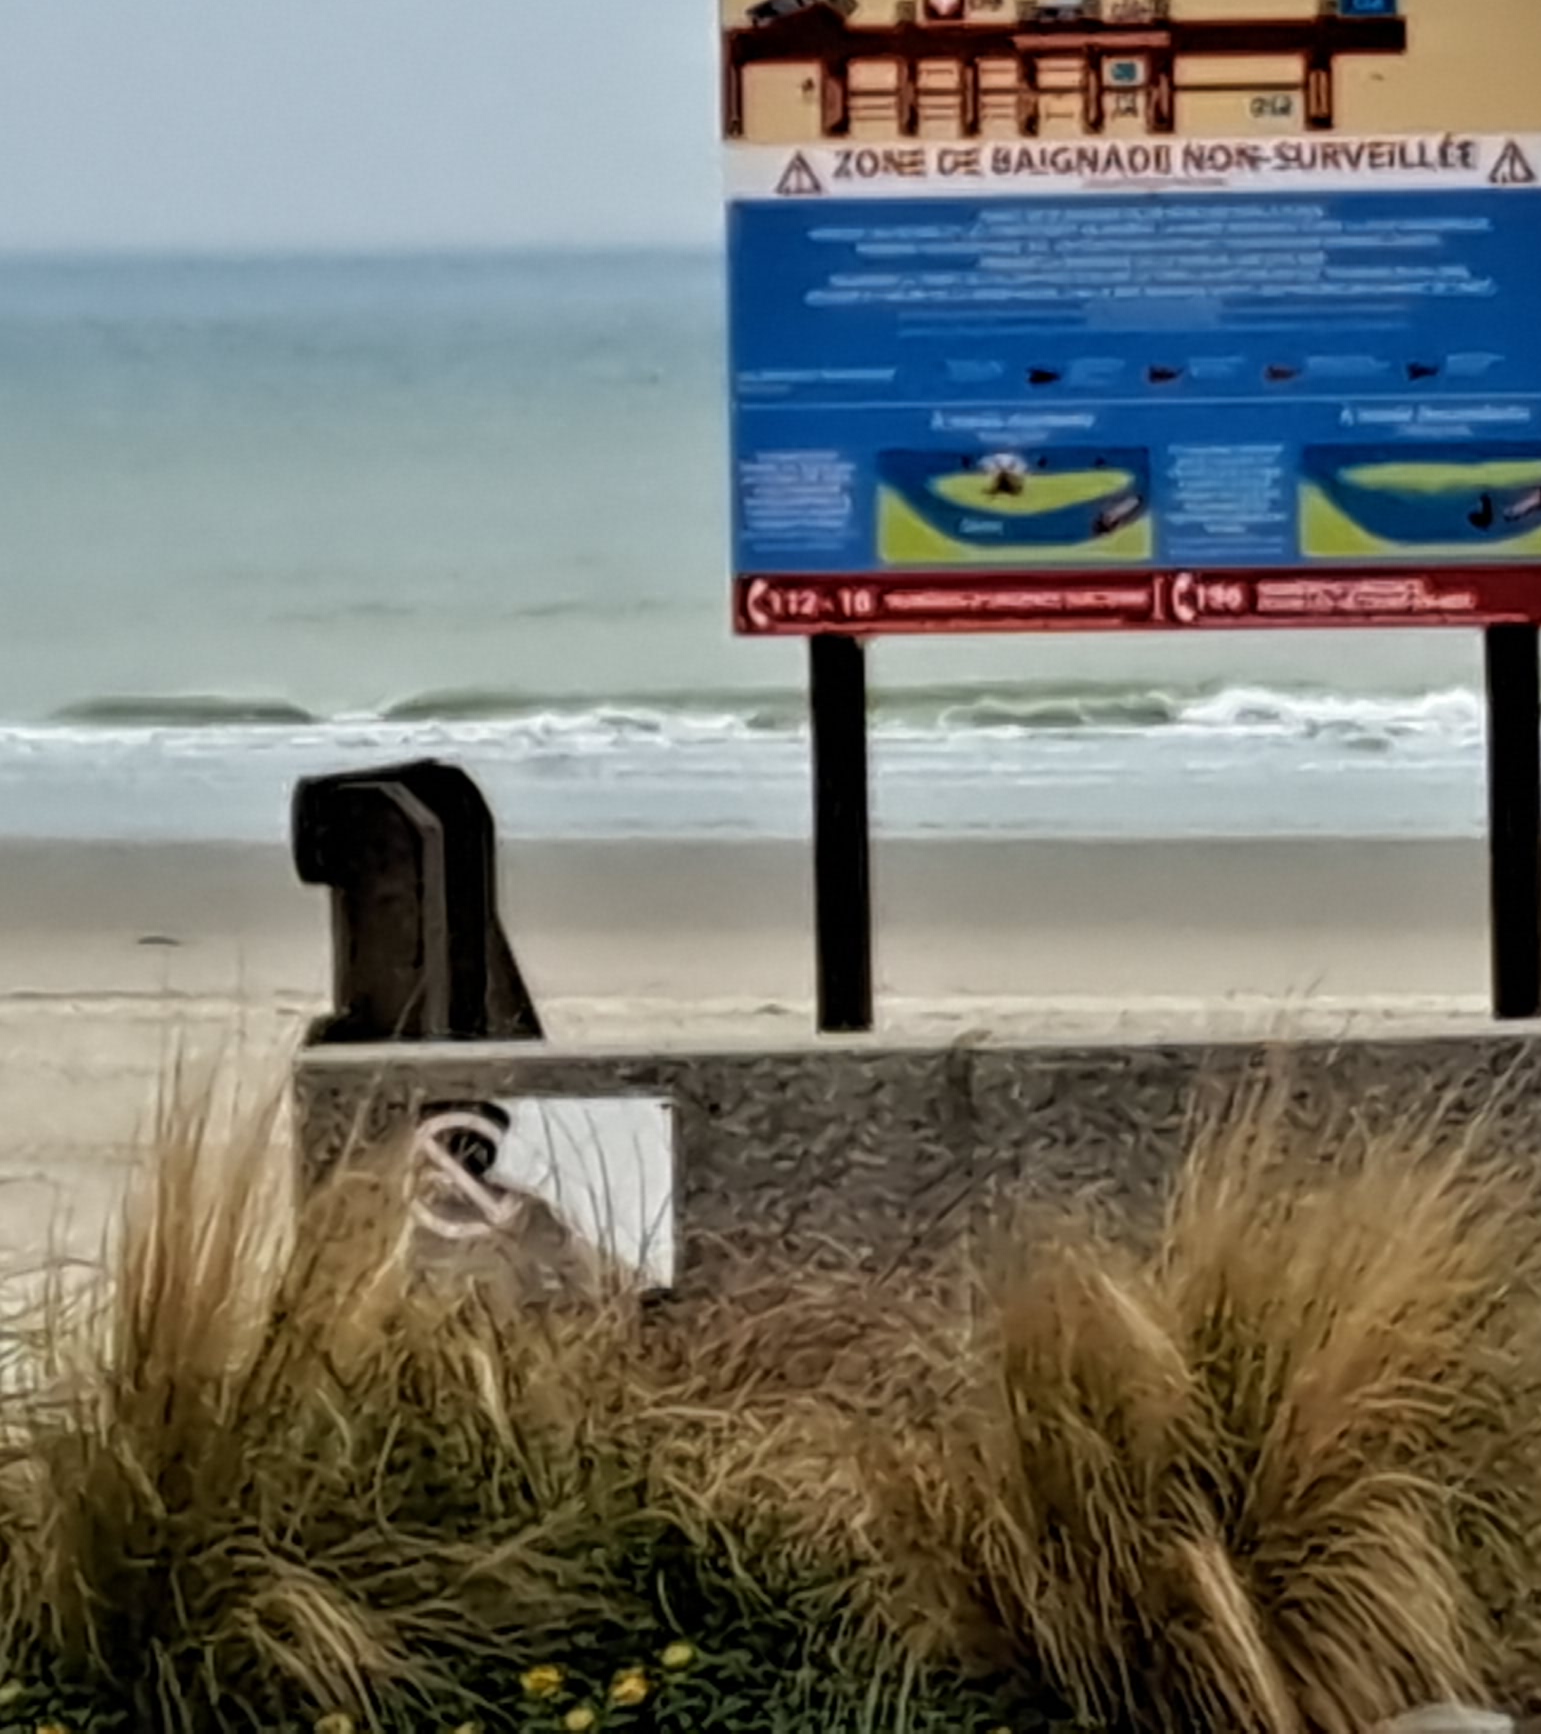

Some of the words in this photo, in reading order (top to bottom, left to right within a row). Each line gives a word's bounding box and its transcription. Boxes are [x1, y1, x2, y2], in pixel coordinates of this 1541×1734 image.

[832, 148, 925, 179] ZONE
[936, 147, 980, 177] DE
[990, 144, 1173, 176] BAIGNADE
[1183, 132, 1478, 173] NON-SURVEILLÉE
